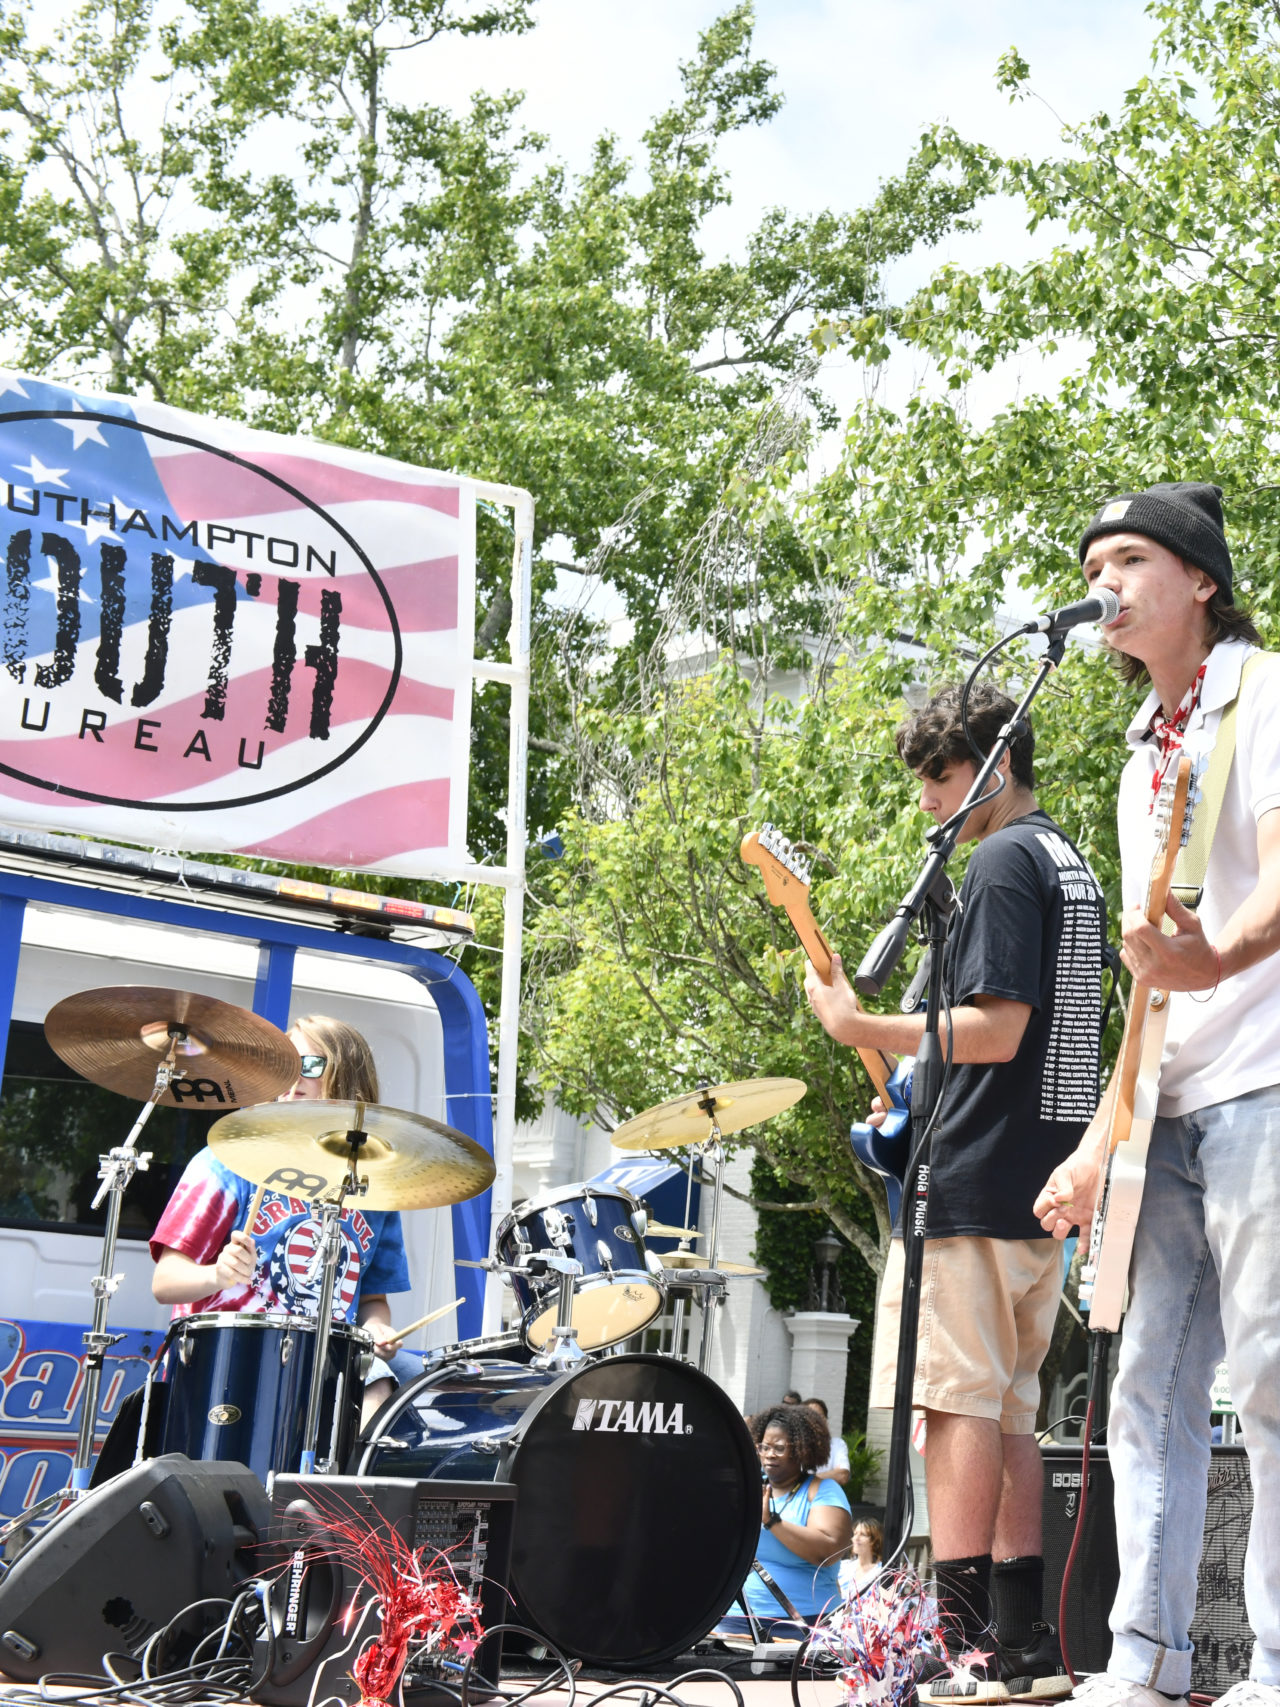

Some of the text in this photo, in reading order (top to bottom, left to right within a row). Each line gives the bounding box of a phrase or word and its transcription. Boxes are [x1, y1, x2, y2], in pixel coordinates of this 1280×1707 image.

[8, 484, 337, 578] UTHAMPTON
[21, 698, 266, 770] UREAU
[1061, 884, 1086, 901] TOUR
[914, 1200, 928, 1237] Music
[593, 1399, 685, 1435] TAMA
[285, 1550, 305, 1632] BEHRINGER
